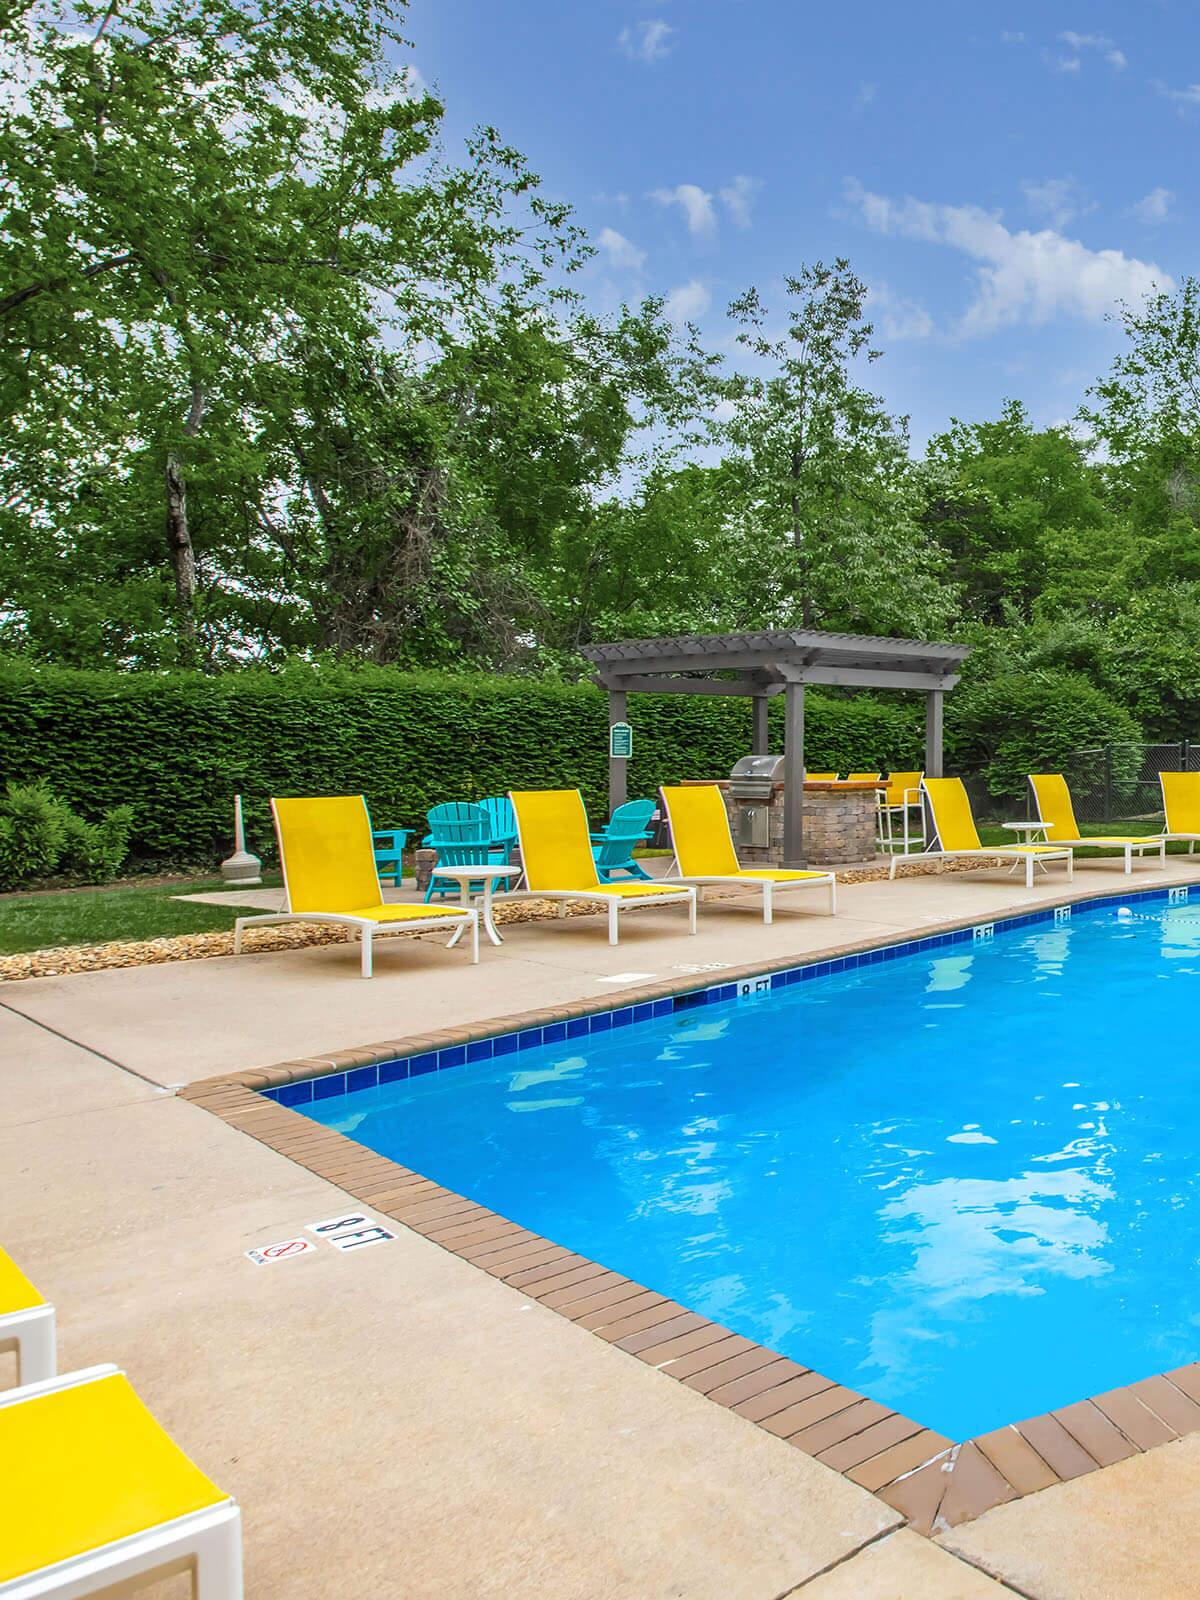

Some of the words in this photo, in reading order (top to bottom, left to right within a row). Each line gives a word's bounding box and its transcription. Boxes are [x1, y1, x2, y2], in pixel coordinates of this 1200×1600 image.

[756, 979, 769, 993] FT
[316, 1217, 366, 1232] 8
[332, 1227, 394, 1249] FT
